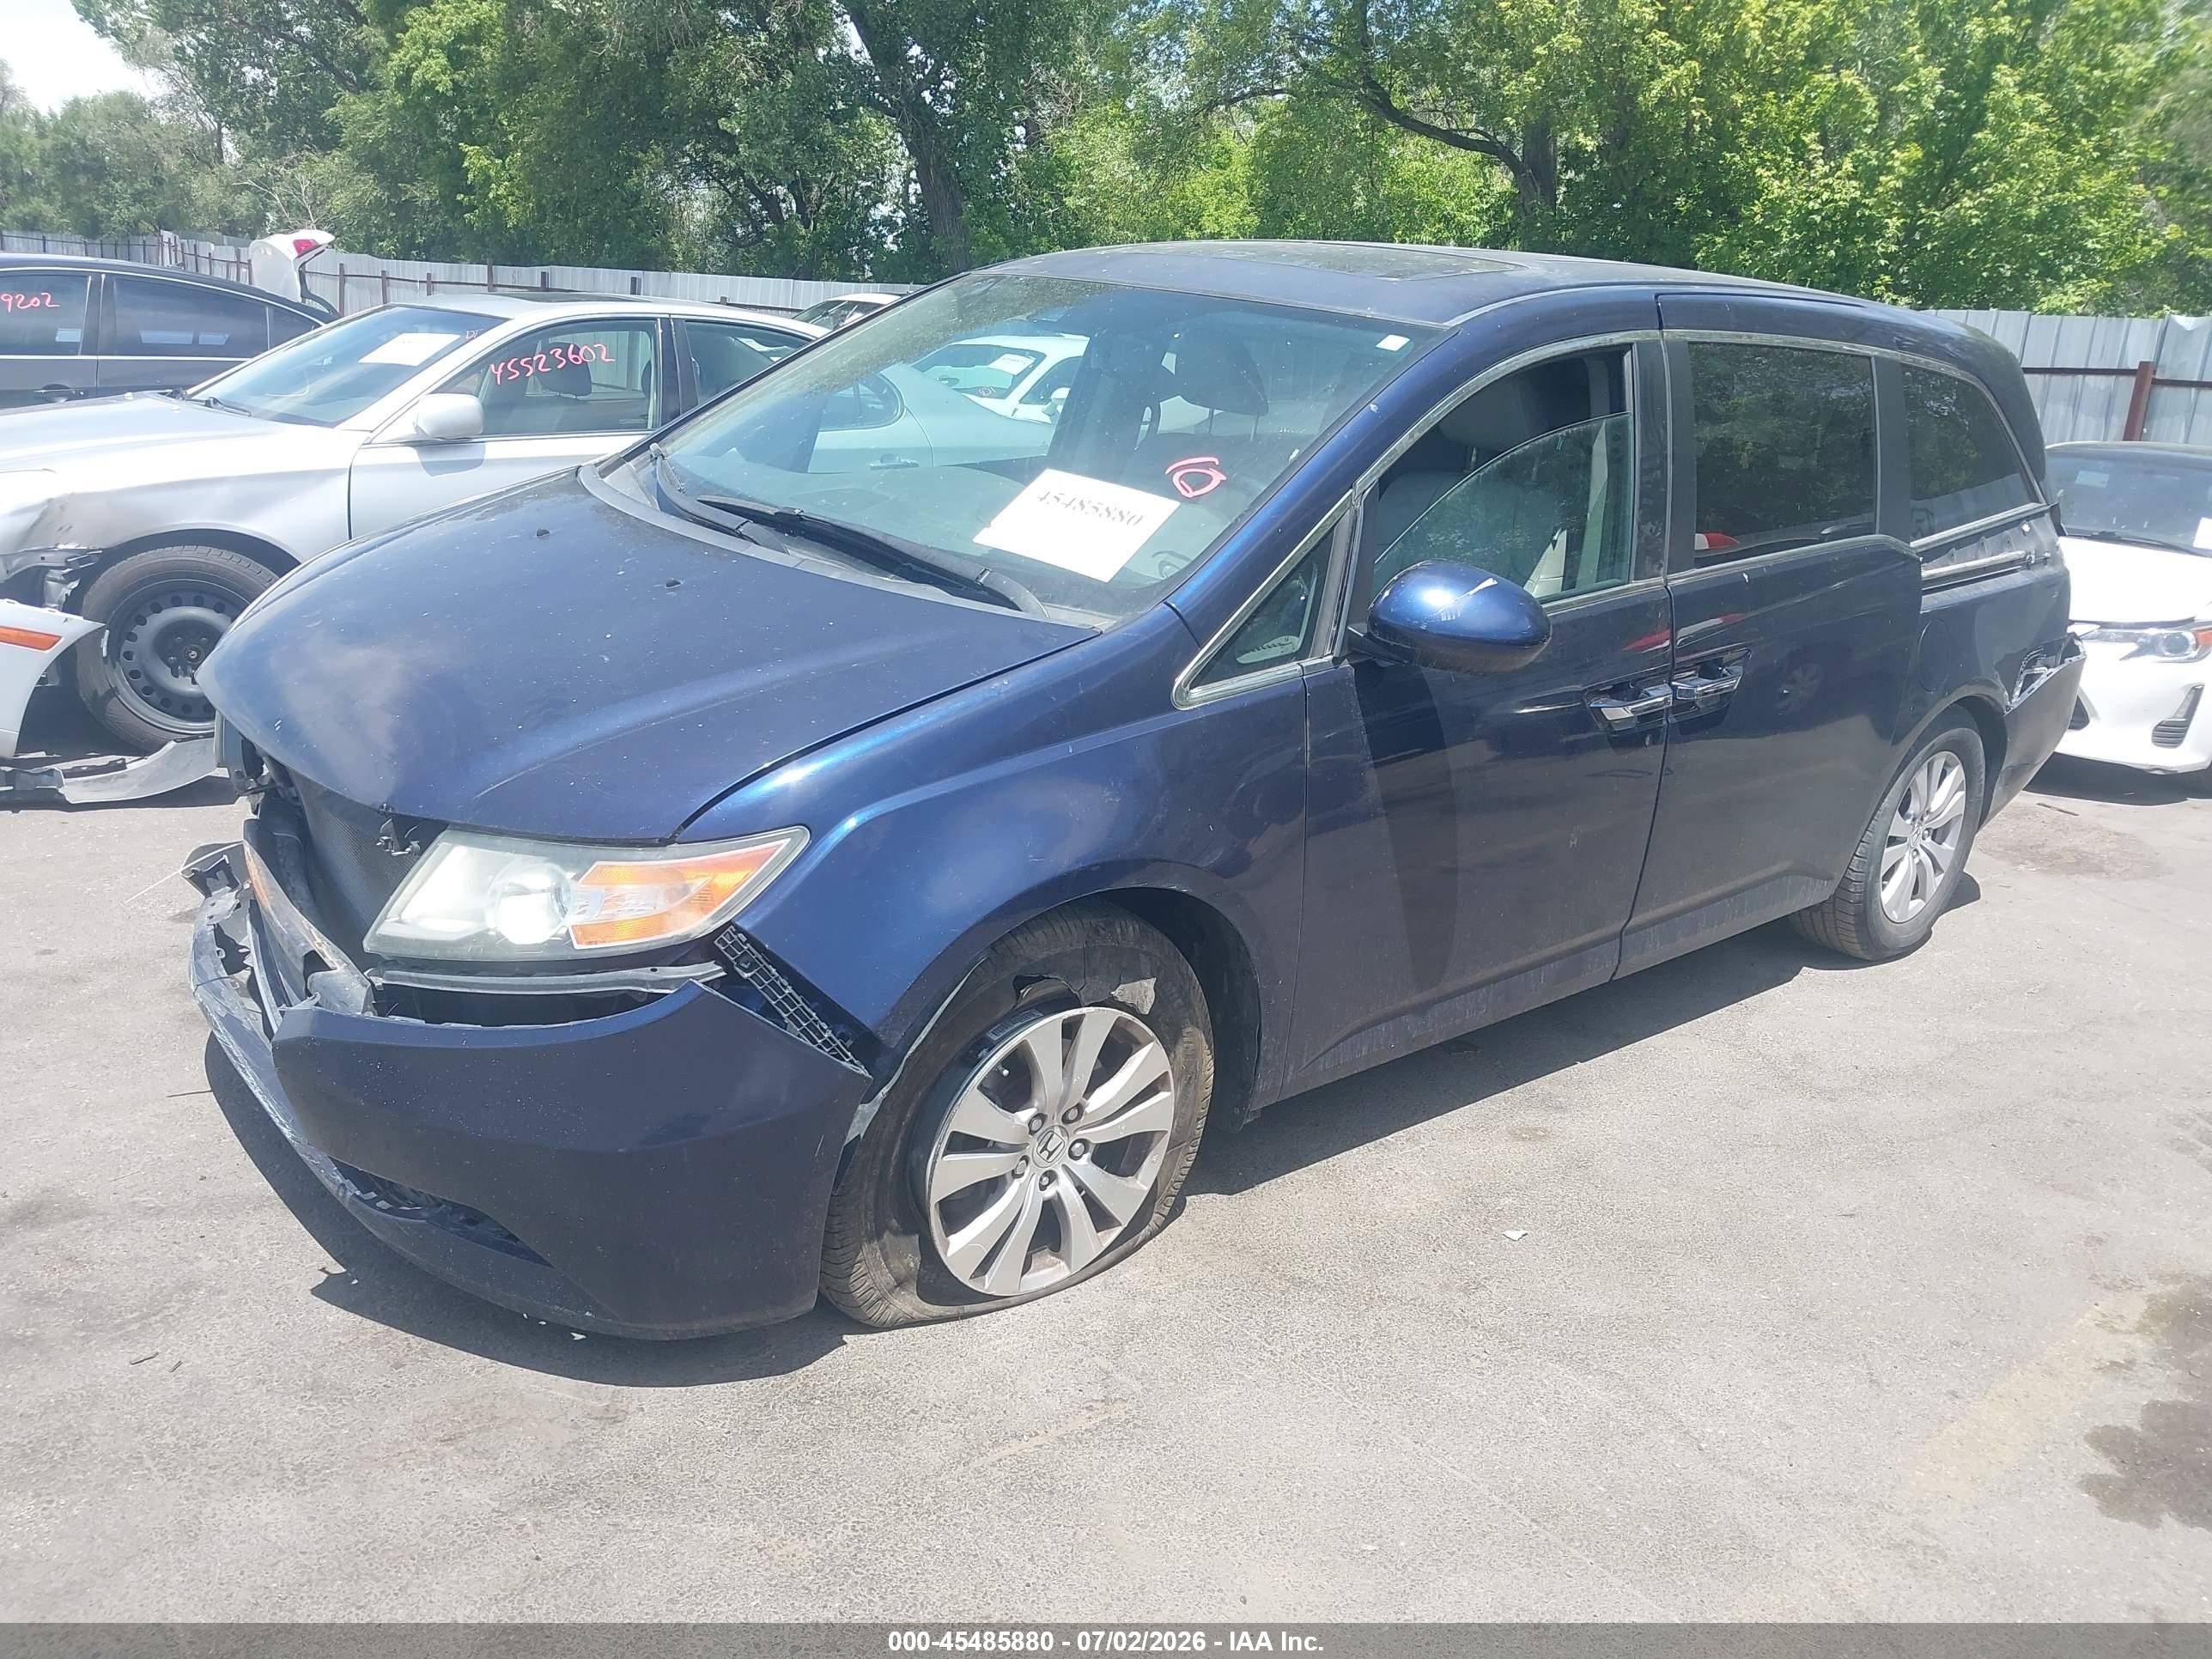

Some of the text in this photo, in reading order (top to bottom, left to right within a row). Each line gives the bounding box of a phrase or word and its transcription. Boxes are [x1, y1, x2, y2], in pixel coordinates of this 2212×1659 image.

[1, 292, 61, 313] 9202
[490, 343, 616, 386] 45523602
[1036, 490, 1145, 526] 45485880
